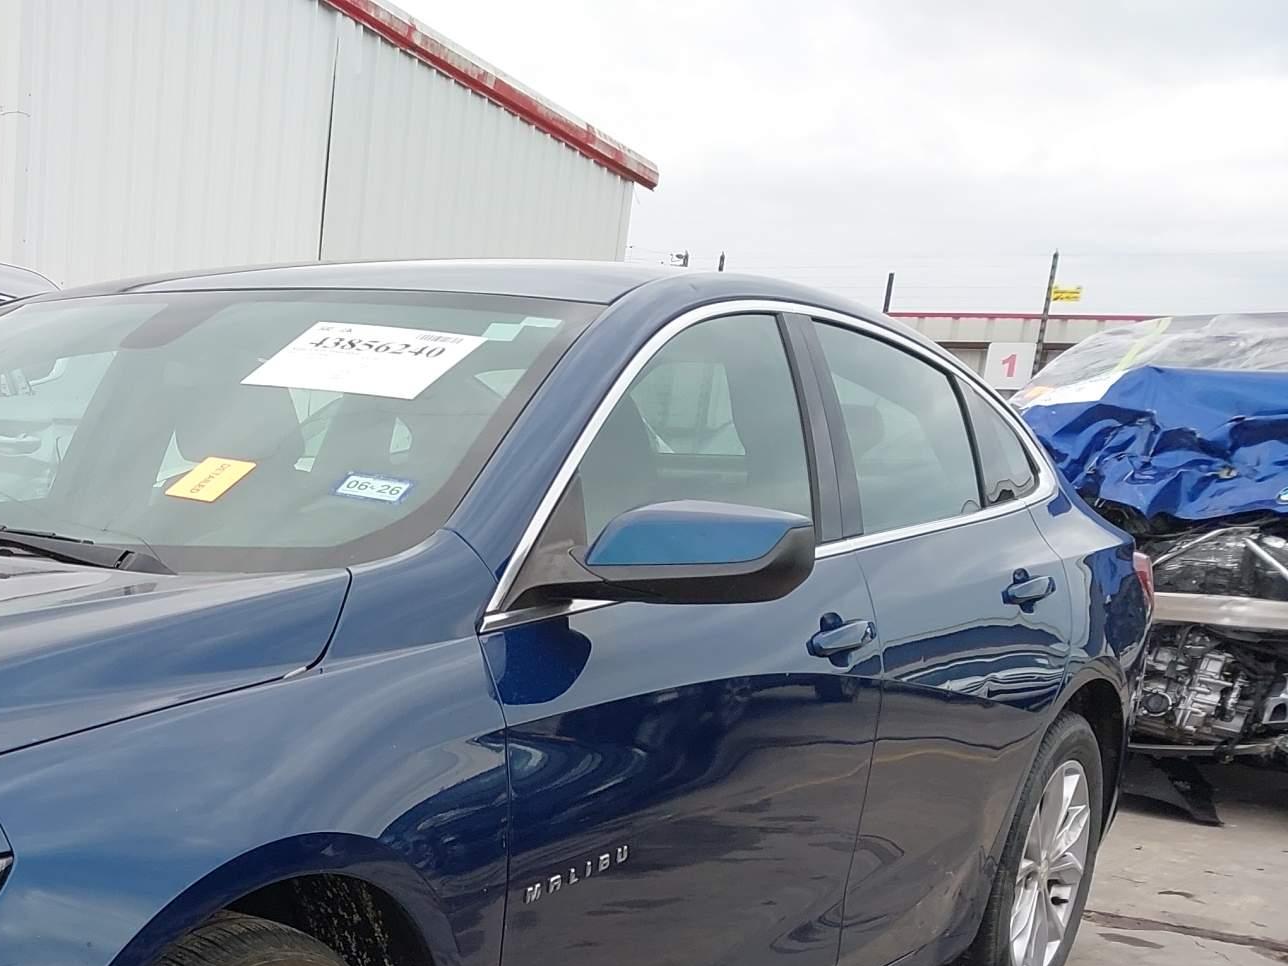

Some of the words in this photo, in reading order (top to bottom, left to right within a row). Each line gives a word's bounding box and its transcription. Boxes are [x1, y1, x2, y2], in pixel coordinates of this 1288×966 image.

[309, 336, 447, 359] 43856240
[1001, 354, 1017, 378] 1
[523, 845, 630, 904] MALIBU
